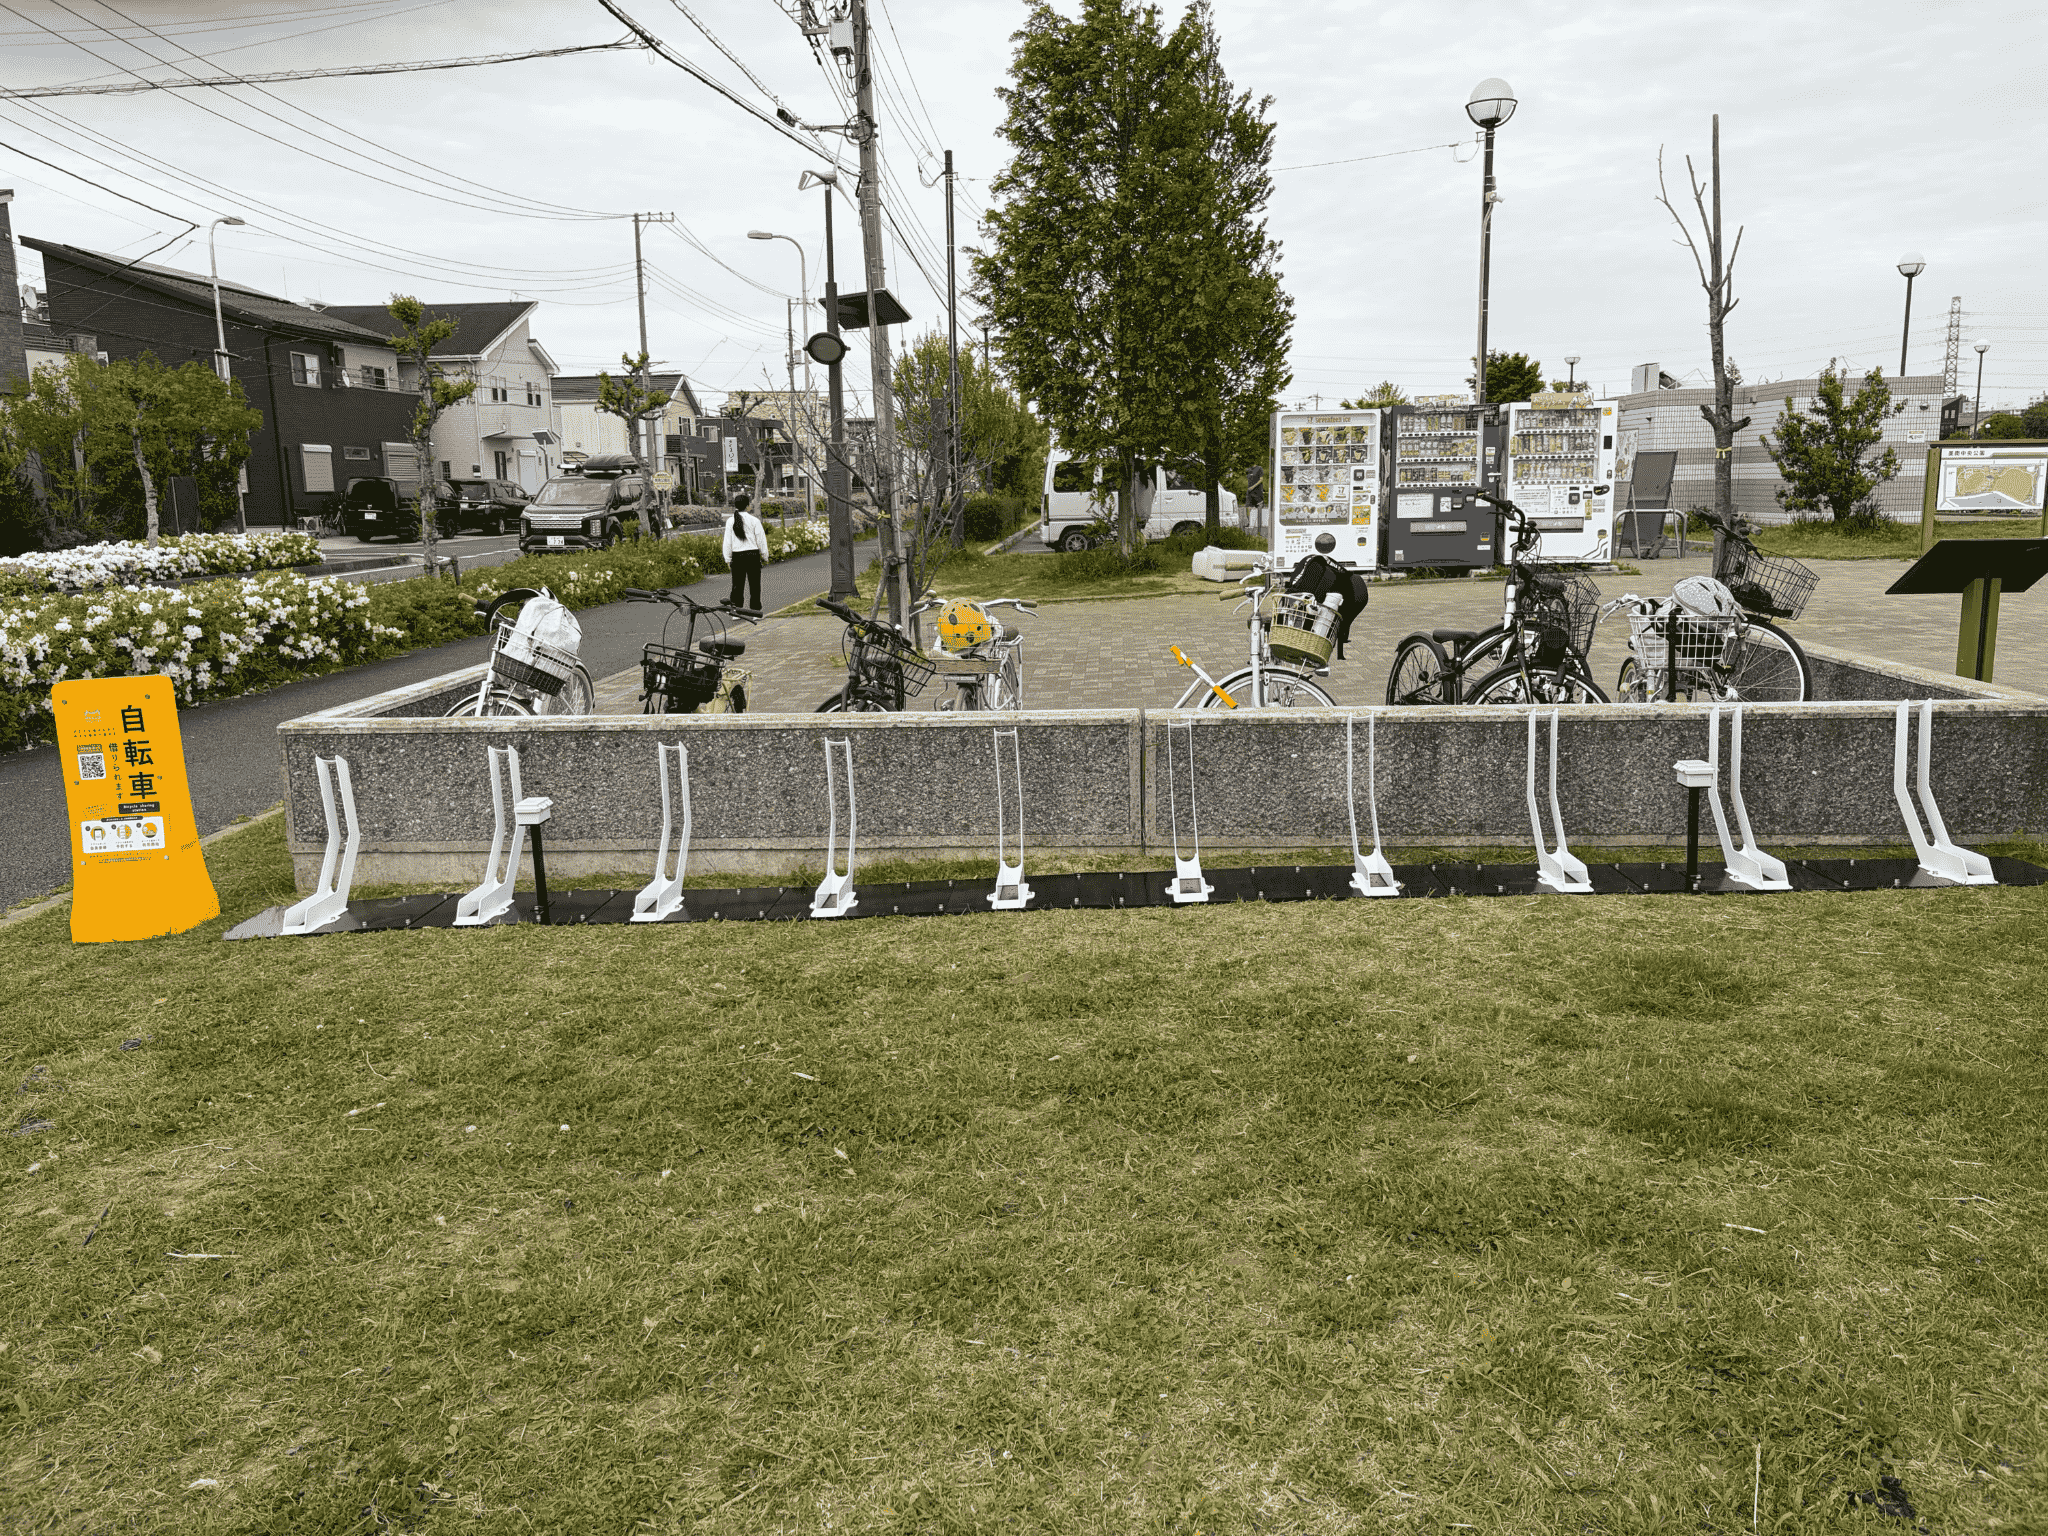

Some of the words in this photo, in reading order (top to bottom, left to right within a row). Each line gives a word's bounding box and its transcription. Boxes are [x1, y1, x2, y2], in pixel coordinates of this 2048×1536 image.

[109, 743, 123, 800] 借りられます
[121, 705, 157, 799] 自転車
